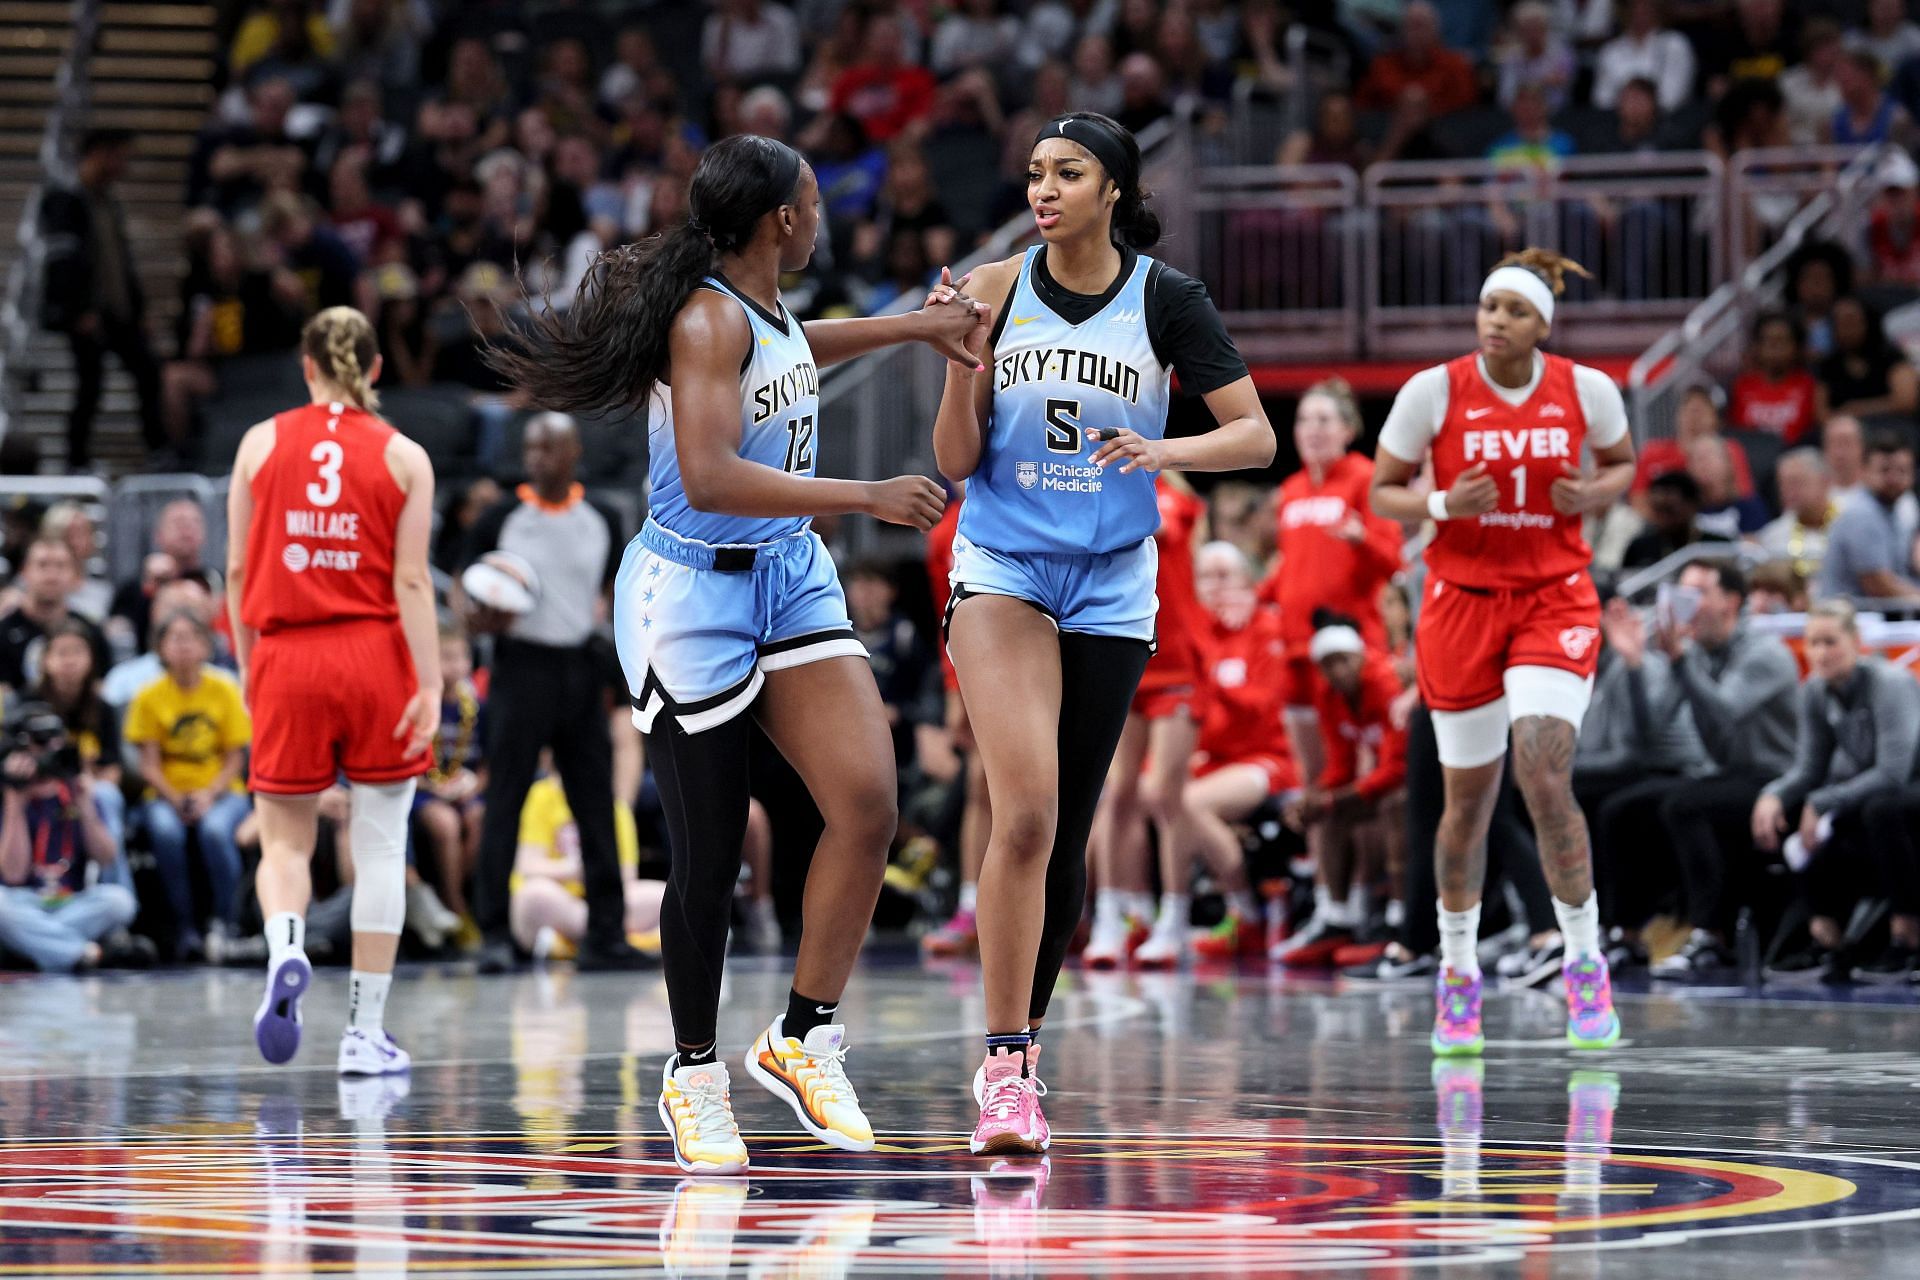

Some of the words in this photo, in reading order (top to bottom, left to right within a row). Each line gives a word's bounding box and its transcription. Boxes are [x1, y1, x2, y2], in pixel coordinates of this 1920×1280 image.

[1045, 397, 1082, 454] 5
[783, 414, 814, 475] 12
[1463, 427, 1570, 461] FEVER
[306, 440, 344, 507] 3
[1042, 462, 1105, 479] UChicago
[1042, 477, 1103, 493] Medicine
[1509, 464, 1527, 508] 1
[286, 510, 359, 540] WALLACE
[312, 549, 361, 571] AT&T
